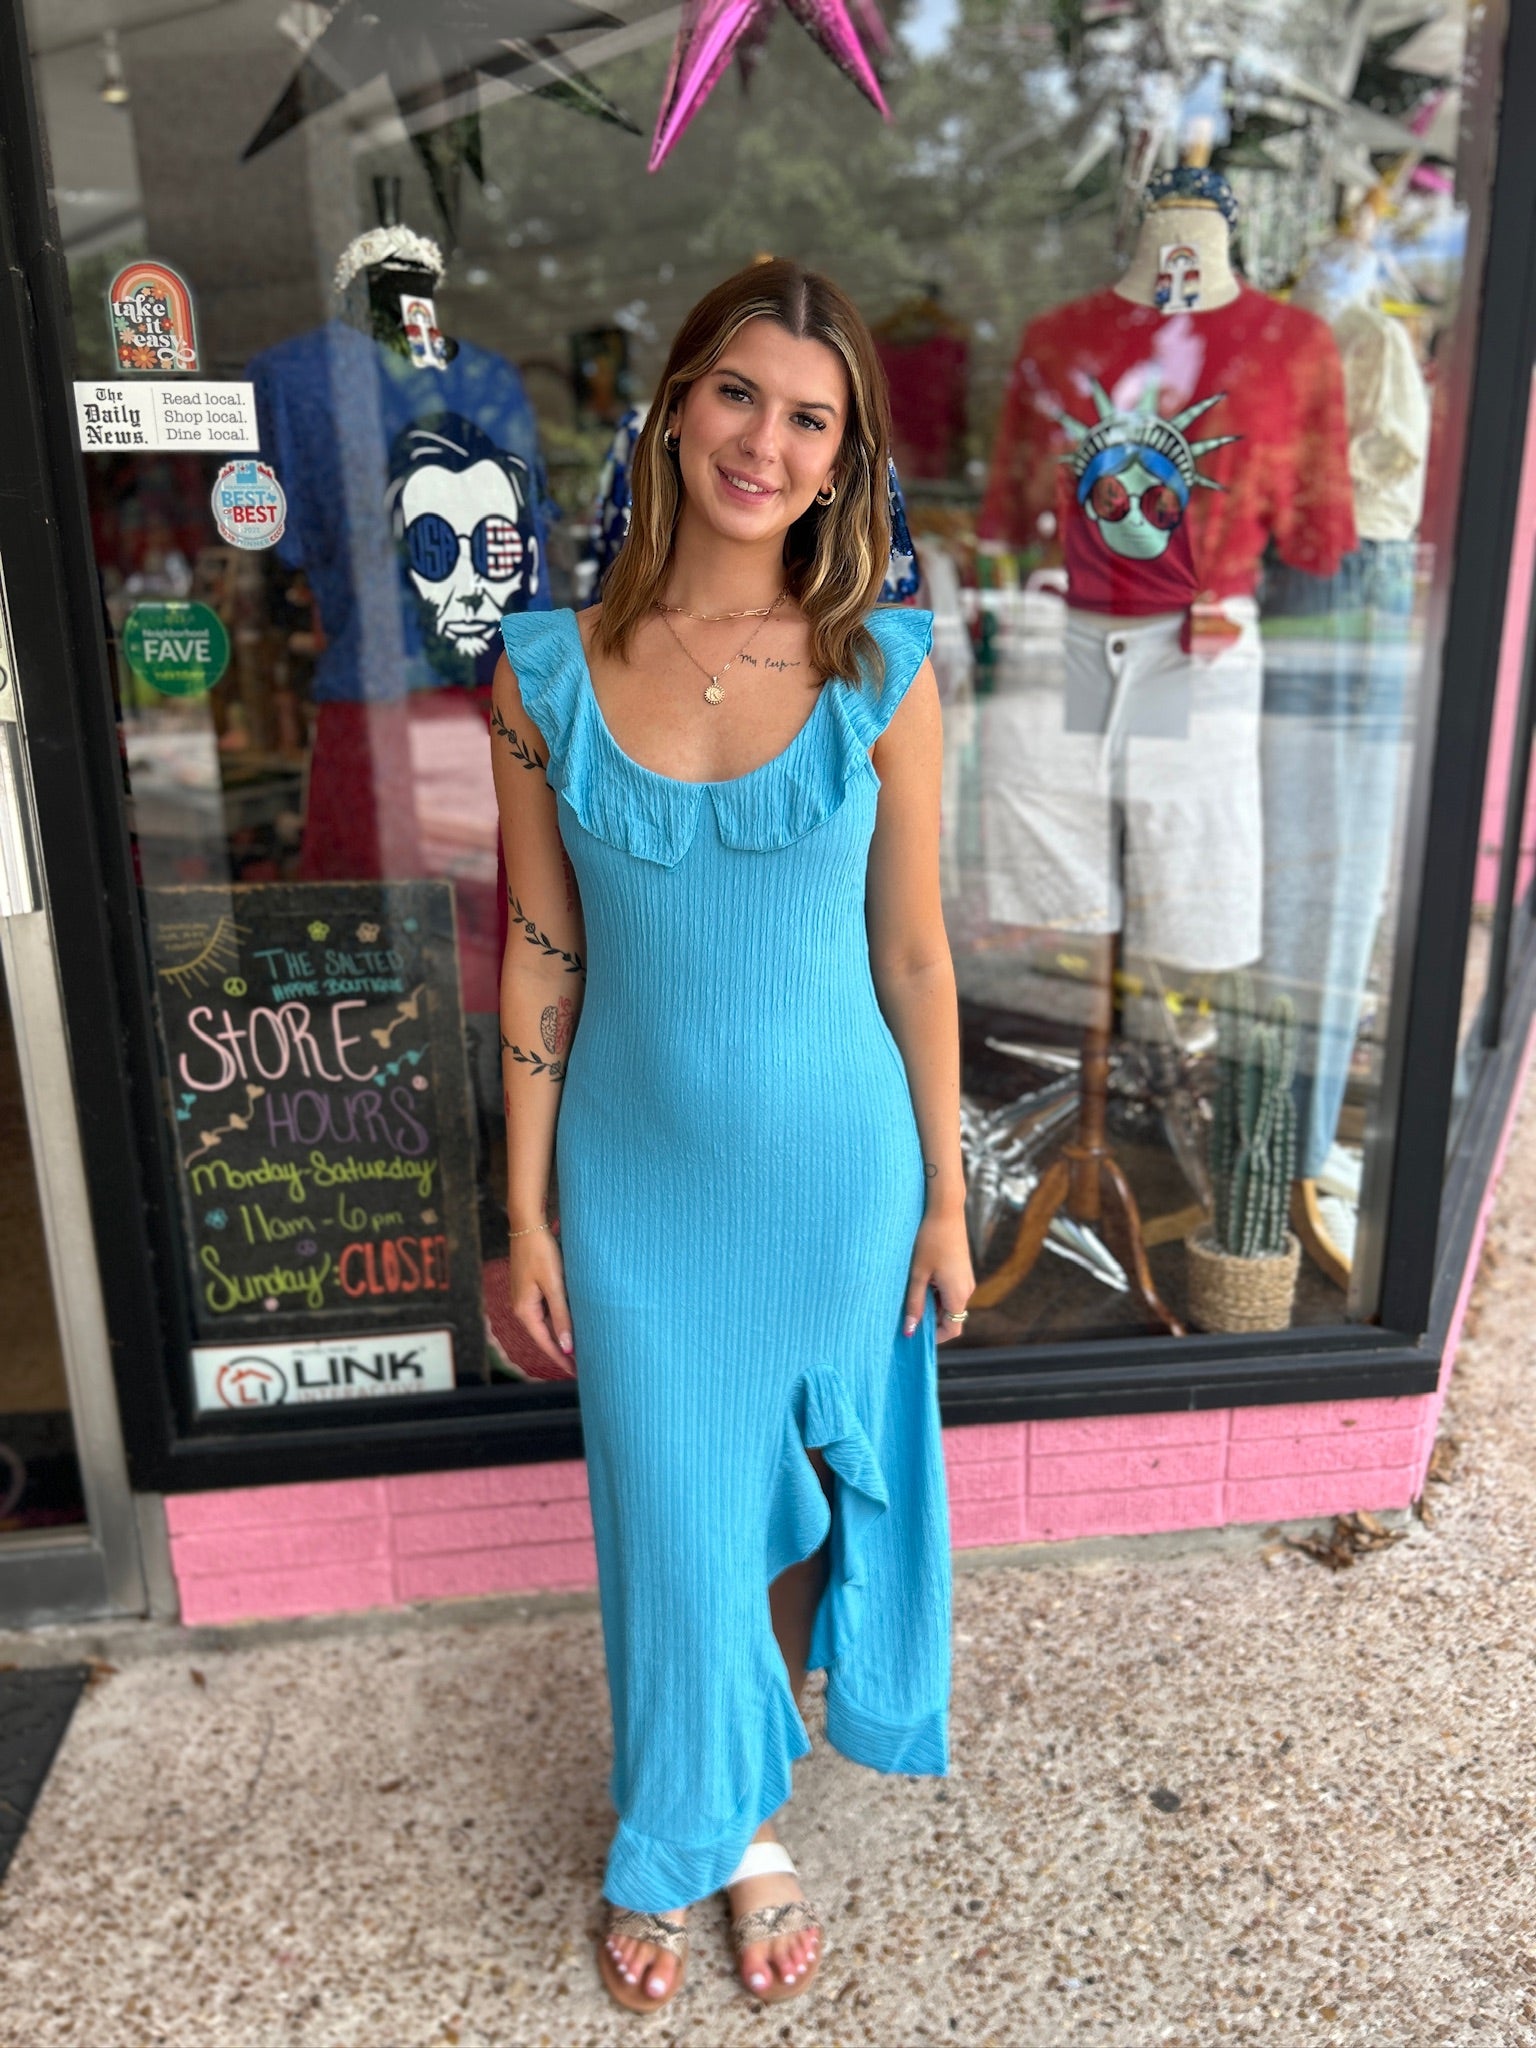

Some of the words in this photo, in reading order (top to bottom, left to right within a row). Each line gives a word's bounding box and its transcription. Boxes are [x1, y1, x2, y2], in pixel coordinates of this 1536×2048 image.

[112, 294, 166, 324] take
[146, 317, 163, 334] it
[133, 334, 197, 369] easy
[95, 388, 123, 403] The
[162, 392, 202, 405] Read
[205, 393, 246, 406] local.
[83, 403, 141, 428] Daily
[164, 410, 203, 426] Shop
[207, 410, 248, 423] local.
[86, 425, 149, 445] News.
[166, 428, 202, 441] Dine
[209, 428, 249, 441] local.
[220, 491, 266, 508] BEST
[233, 506, 277, 524] BEST
[141, 628, 210, 640] Neighborhood
[143, 639, 212, 663] FAVE
[253, 948, 316, 980] THE
[325, 950, 404, 978] SALTED
[265, 1087, 429, 1154] HOURS
[293, 1350, 424, 1388] LINK
